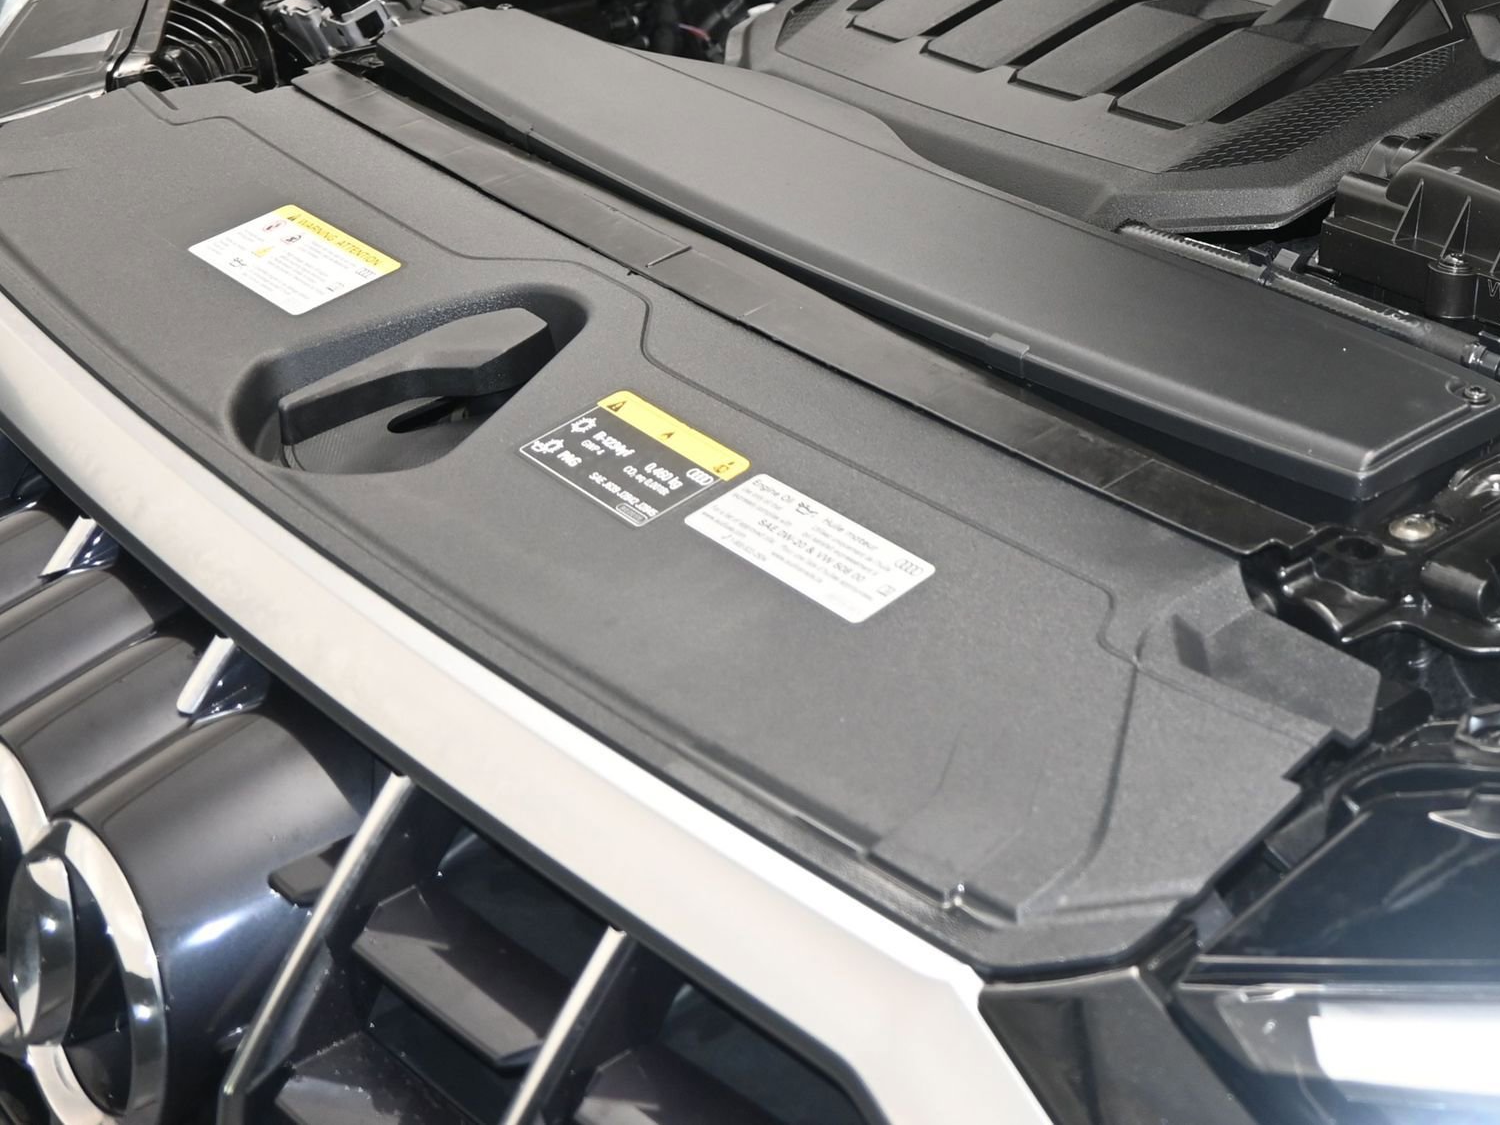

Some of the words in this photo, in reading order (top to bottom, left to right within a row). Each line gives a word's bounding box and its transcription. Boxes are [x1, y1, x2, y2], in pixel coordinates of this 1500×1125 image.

[337, 239, 381, 266] ATTENTION
[752, 478, 781, 497] Engine
[758, 518, 778, 532] SAE
[815, 551, 834, 564] VW
